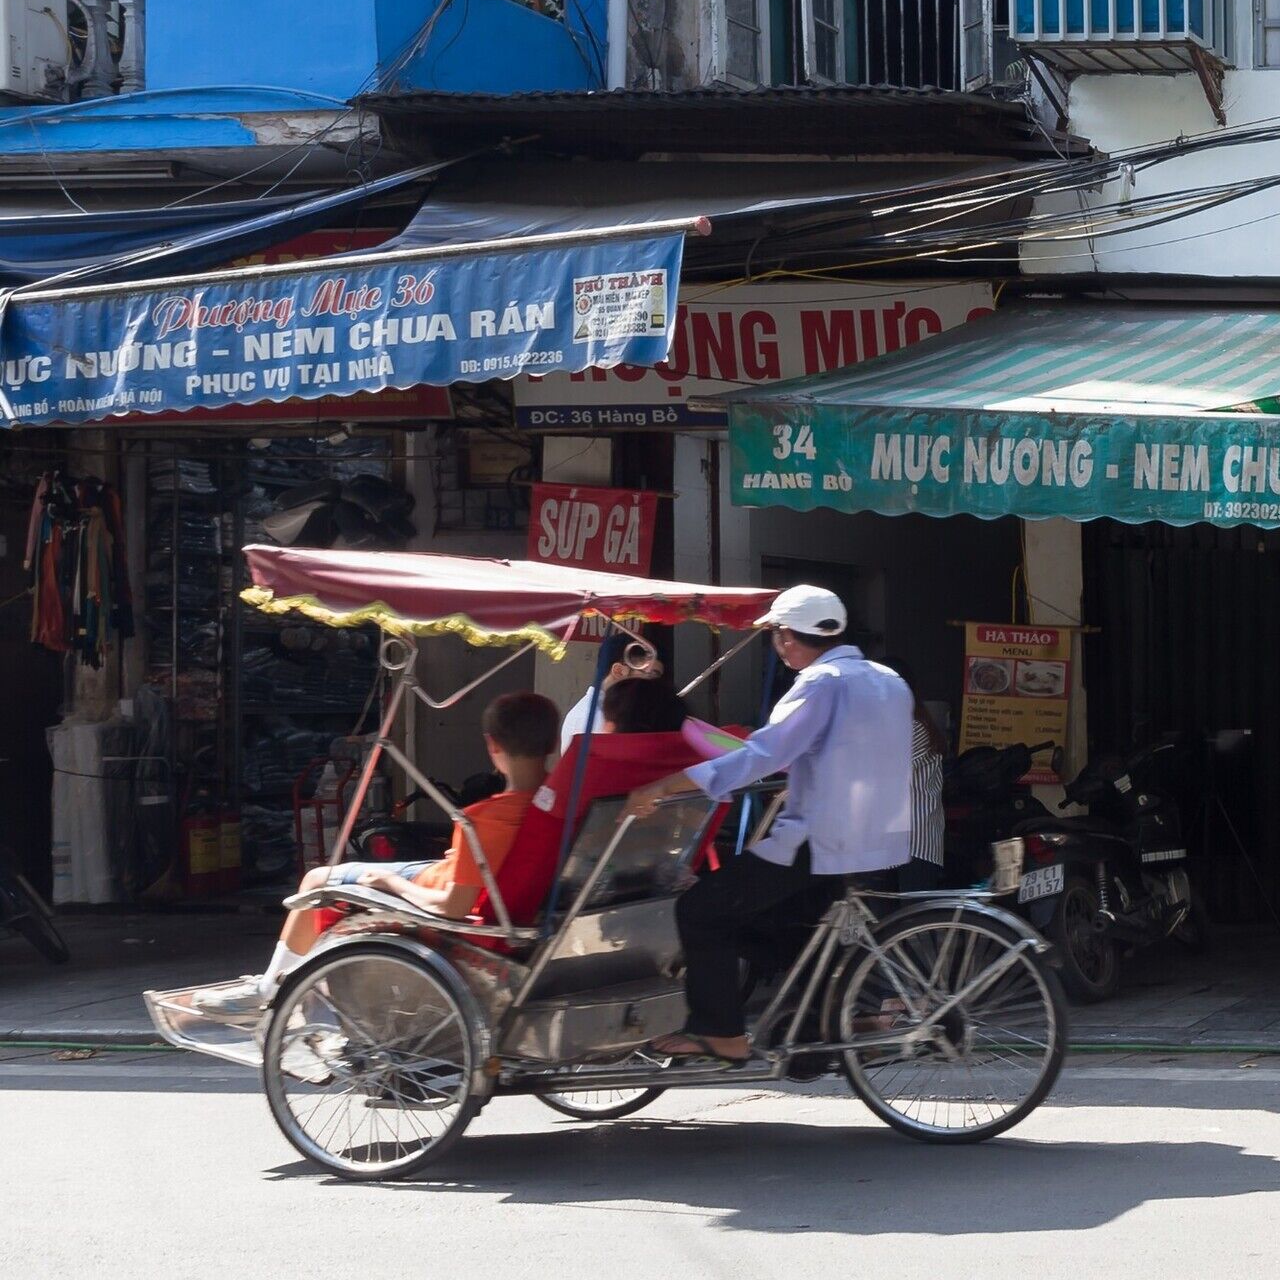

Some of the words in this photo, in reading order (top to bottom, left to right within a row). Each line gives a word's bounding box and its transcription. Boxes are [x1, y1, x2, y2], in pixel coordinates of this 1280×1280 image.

[153, 292, 295, 340] Phượng
[302, 277, 383, 320] Mực
[391, 266, 443, 309] 36
[0, 355, 52, 392] ỰC
[244, 326, 335, 363] NEM
[349, 313, 458, 351] CHUA
[469, 300, 556, 339] RÁN
[185, 371, 256, 398] PHỤC
[263, 365, 291, 392] VỤ
[297, 362, 341, 388] TẠI
[348, 351, 396, 381] NHÀ
[531, 409, 567, 425] ĐC:
[571, 408, 595, 425] 36
[599, 407, 648, 429] Hàng
[772, 423, 817, 461] 34
[870, 432, 951, 496] MỰC
[1132, 442, 1211, 493] NEM
[743, 470, 812, 490] HÀNG
[537, 488, 601, 561] SÚP
[1001, 647, 1034, 657] MENU
